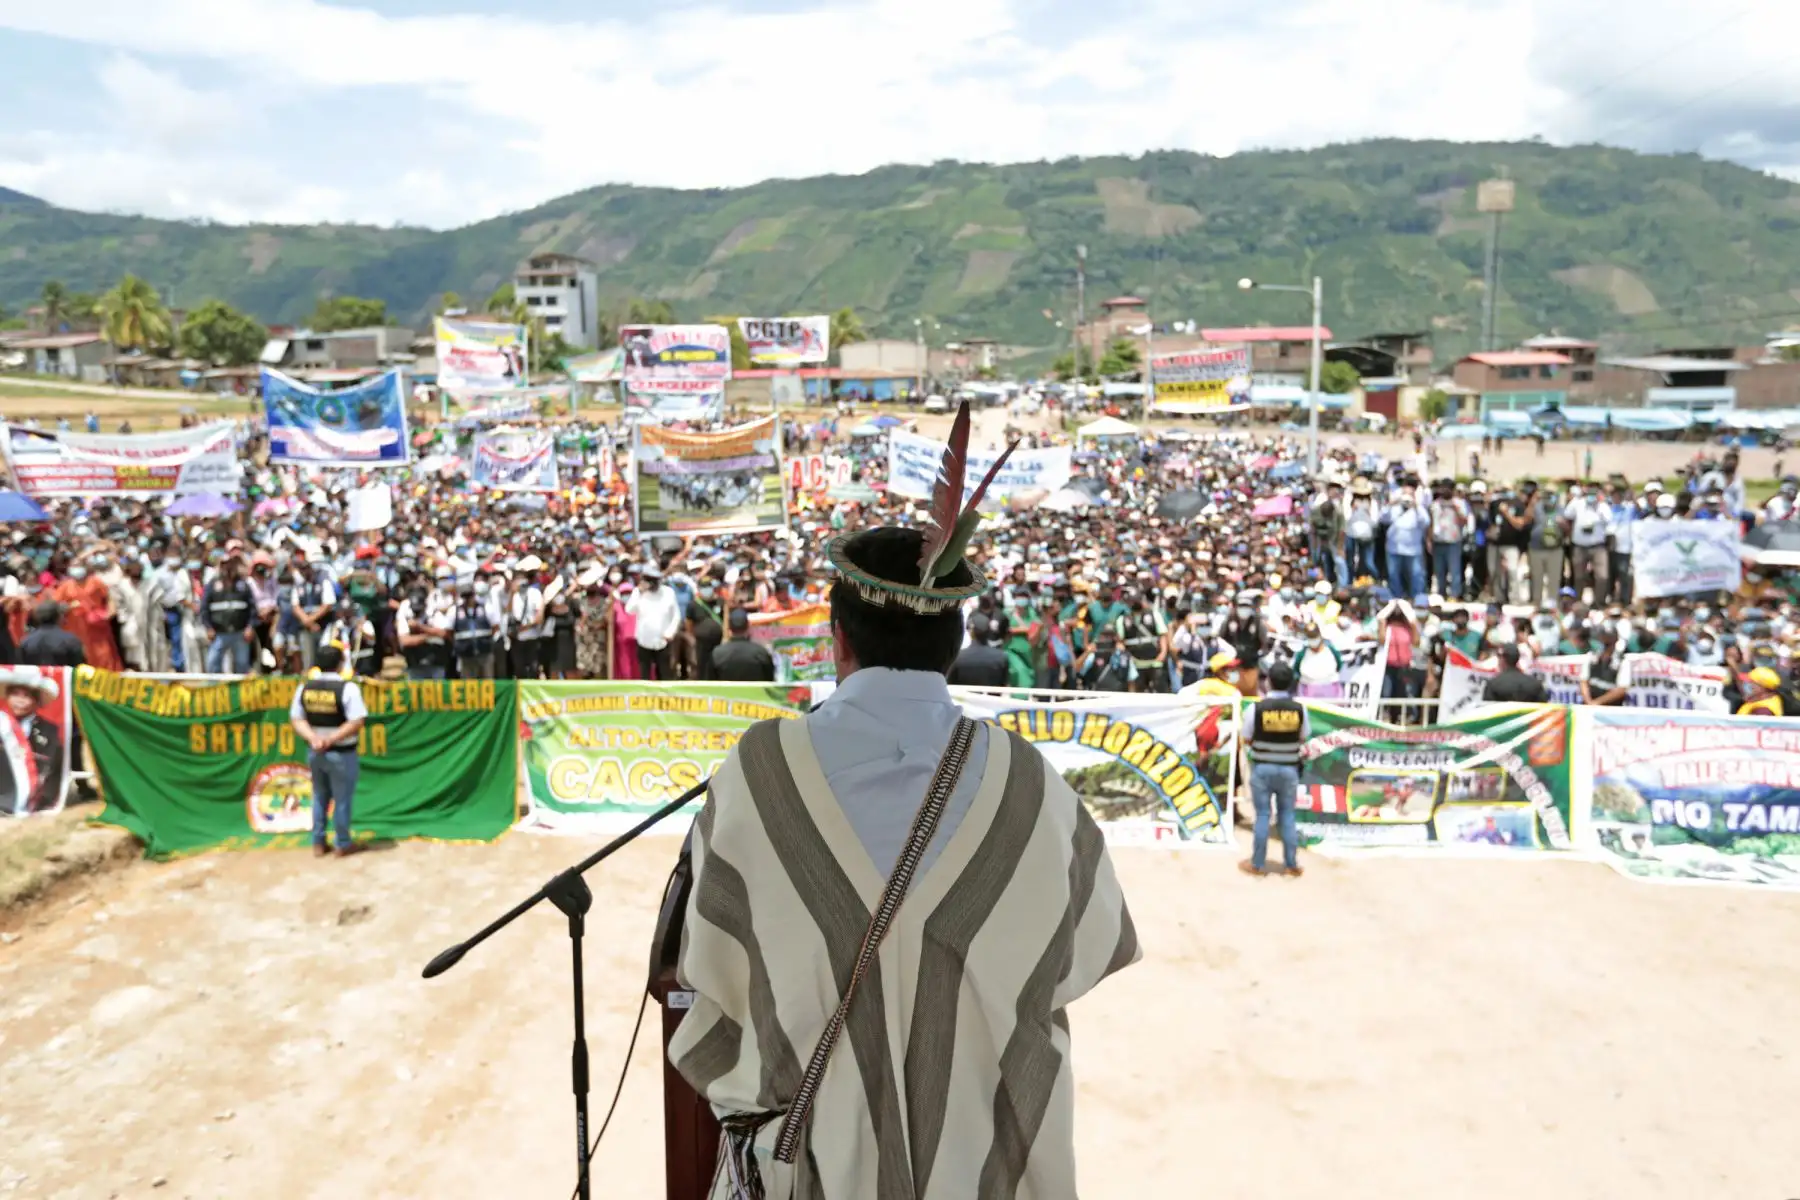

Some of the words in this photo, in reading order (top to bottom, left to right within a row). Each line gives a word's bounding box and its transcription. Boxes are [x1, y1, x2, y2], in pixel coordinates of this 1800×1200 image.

[745, 320, 800, 339] CGTP
[363, 680, 495, 714] AFETALERA
[189, 722, 295, 755] SATIPO
[569, 727, 745, 751] ALTO-PEREN
[984, 708, 1075, 743] ELLO
[1352, 750, 1453, 767] PRESENTE
[550, 758, 722, 801] CACS
[1722, 803, 1800, 832] TAM
